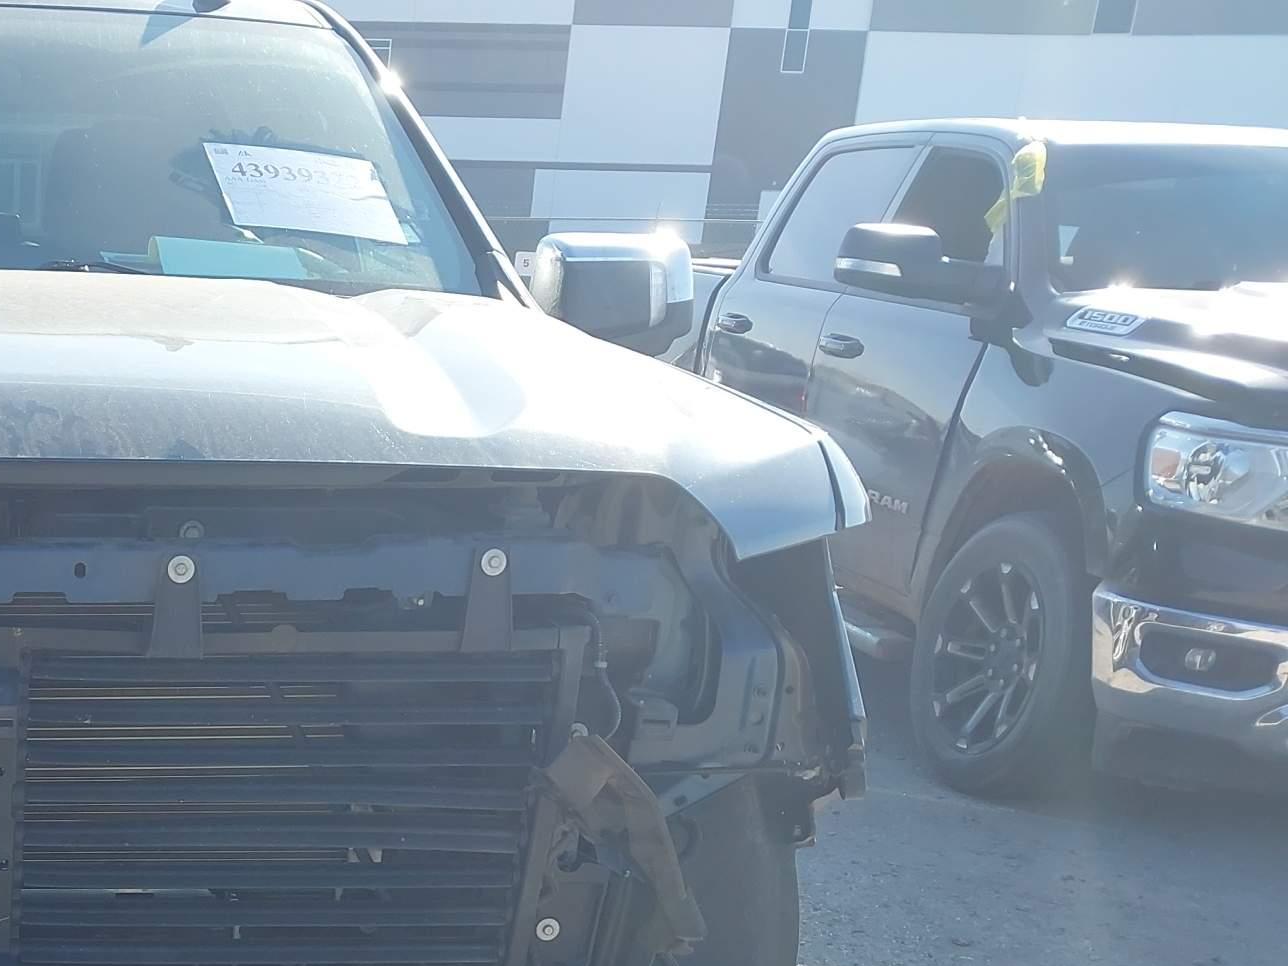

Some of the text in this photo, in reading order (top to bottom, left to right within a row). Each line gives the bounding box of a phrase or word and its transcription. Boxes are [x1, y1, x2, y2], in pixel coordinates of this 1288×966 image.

[522, 258, 530, 268] 5
[1083, 310, 1133, 326] 1500
[867, 488, 908, 515] RAM
